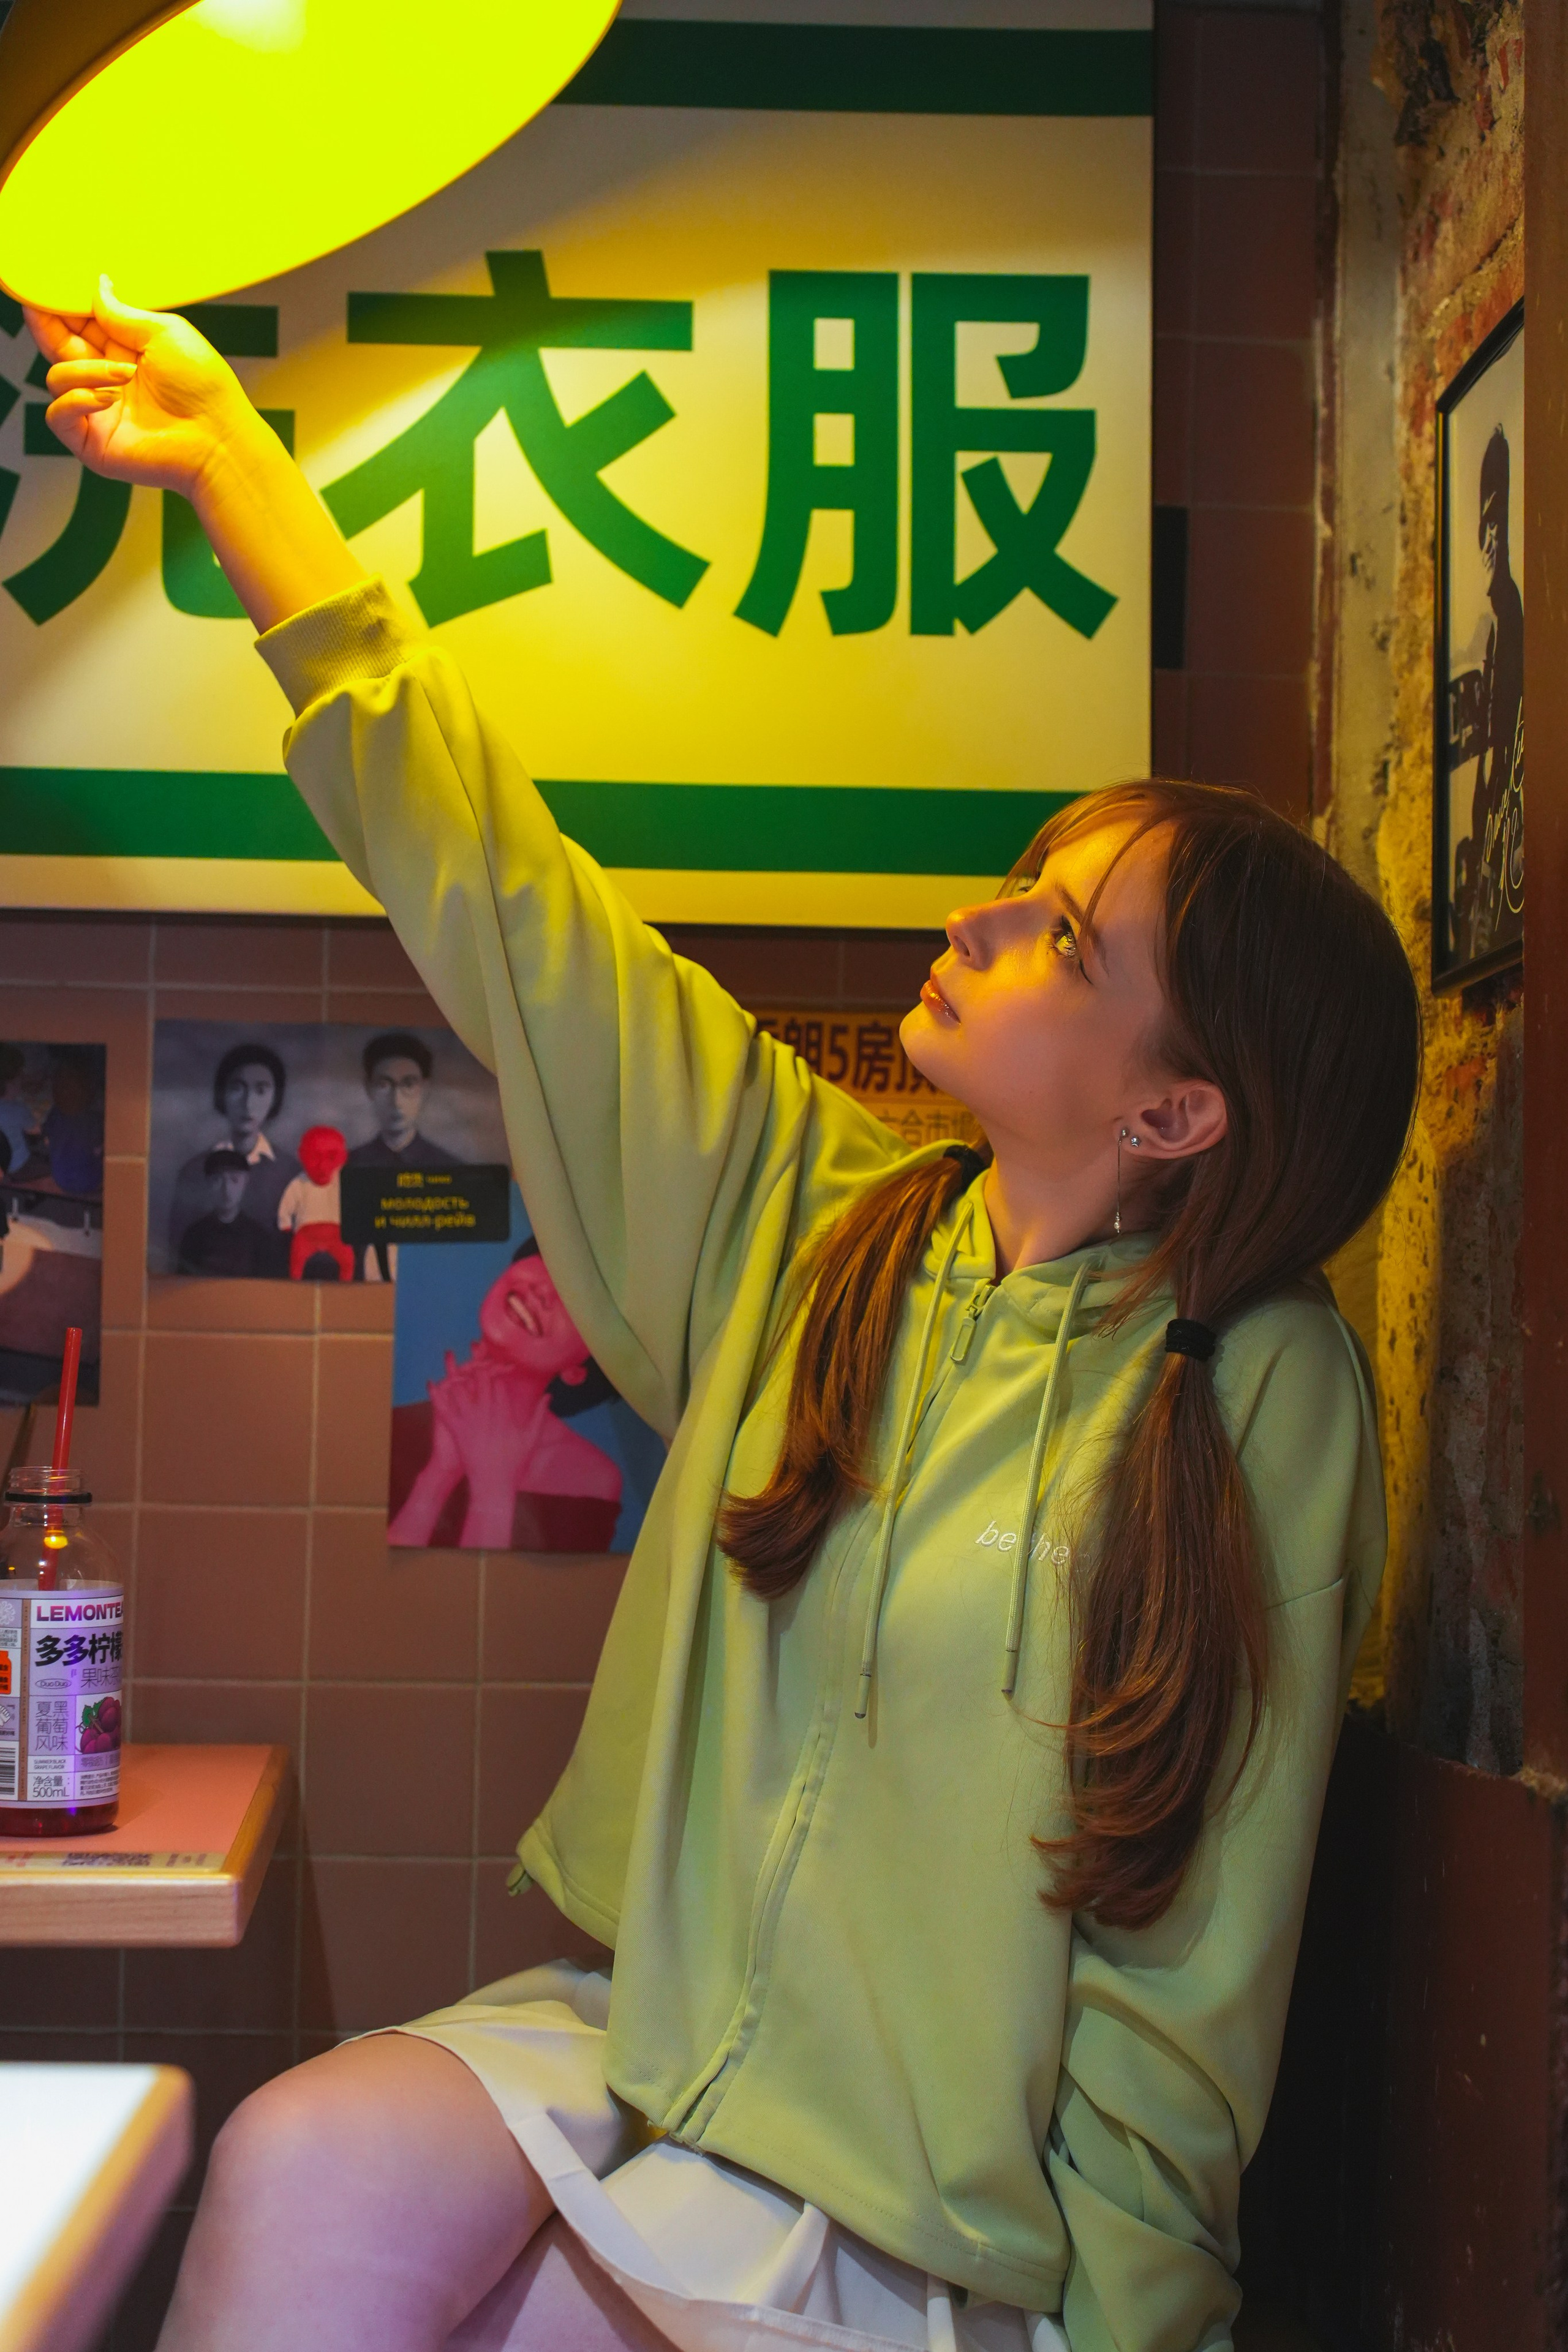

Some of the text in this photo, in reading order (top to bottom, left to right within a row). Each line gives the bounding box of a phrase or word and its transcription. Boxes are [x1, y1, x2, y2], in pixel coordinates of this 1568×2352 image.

[975, 1521, 1017, 1552] be
[1029, 1532, 1071, 1566] he
[36, 1602, 123, 1622] LEMONTE
[36, 1735, 68, 1752] 风味
